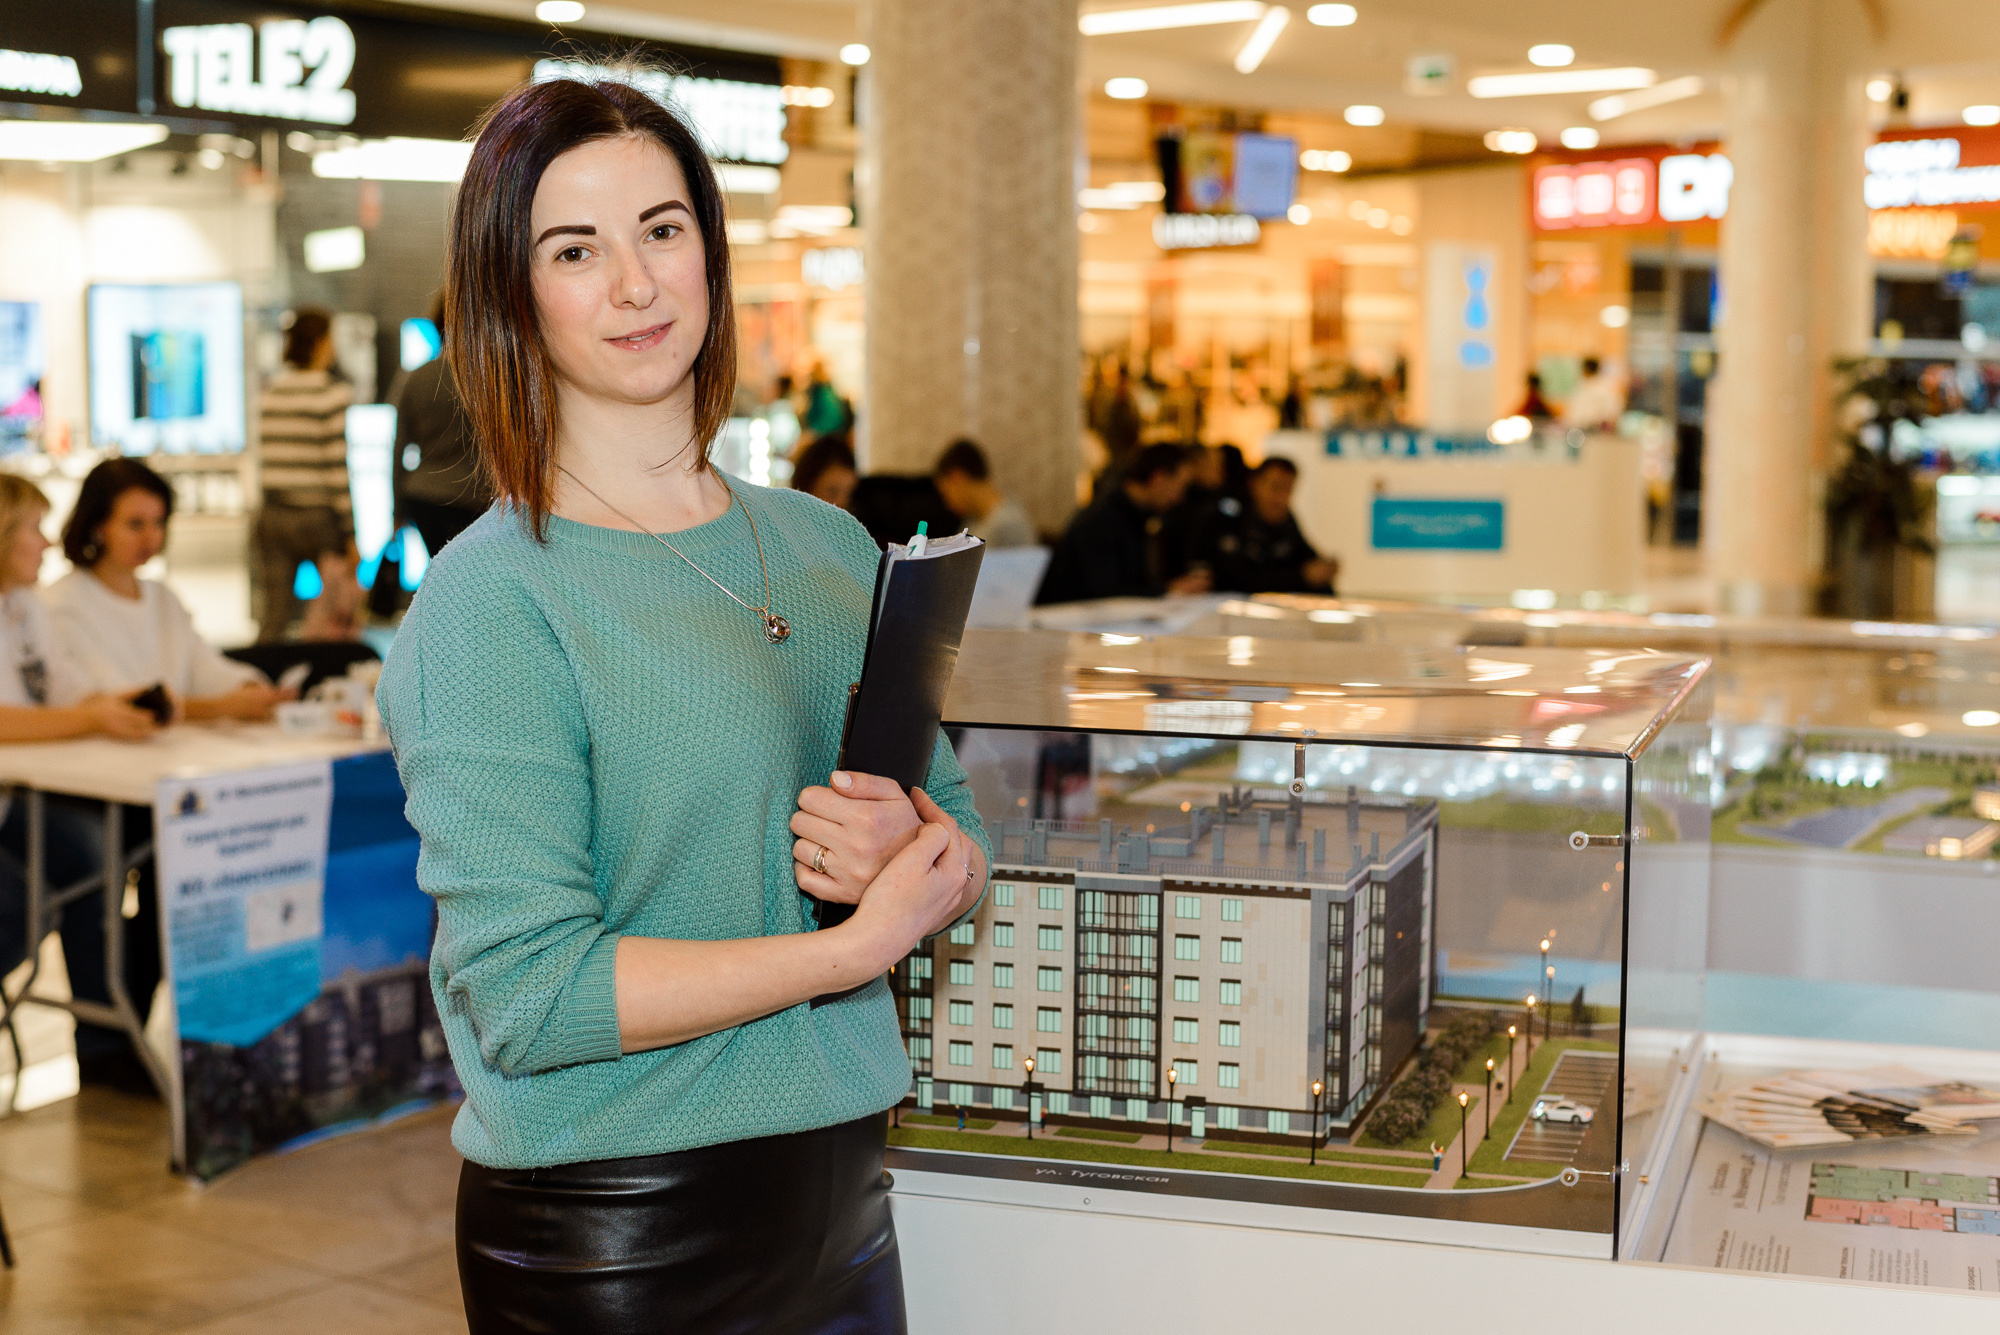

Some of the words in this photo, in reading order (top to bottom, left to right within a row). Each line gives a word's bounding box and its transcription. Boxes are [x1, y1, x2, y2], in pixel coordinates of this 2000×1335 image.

[163, 16, 356, 125] TELE2
[1035, 1167, 1062, 1176] ул.
[1070, 1169, 1170, 1183] Туговская
